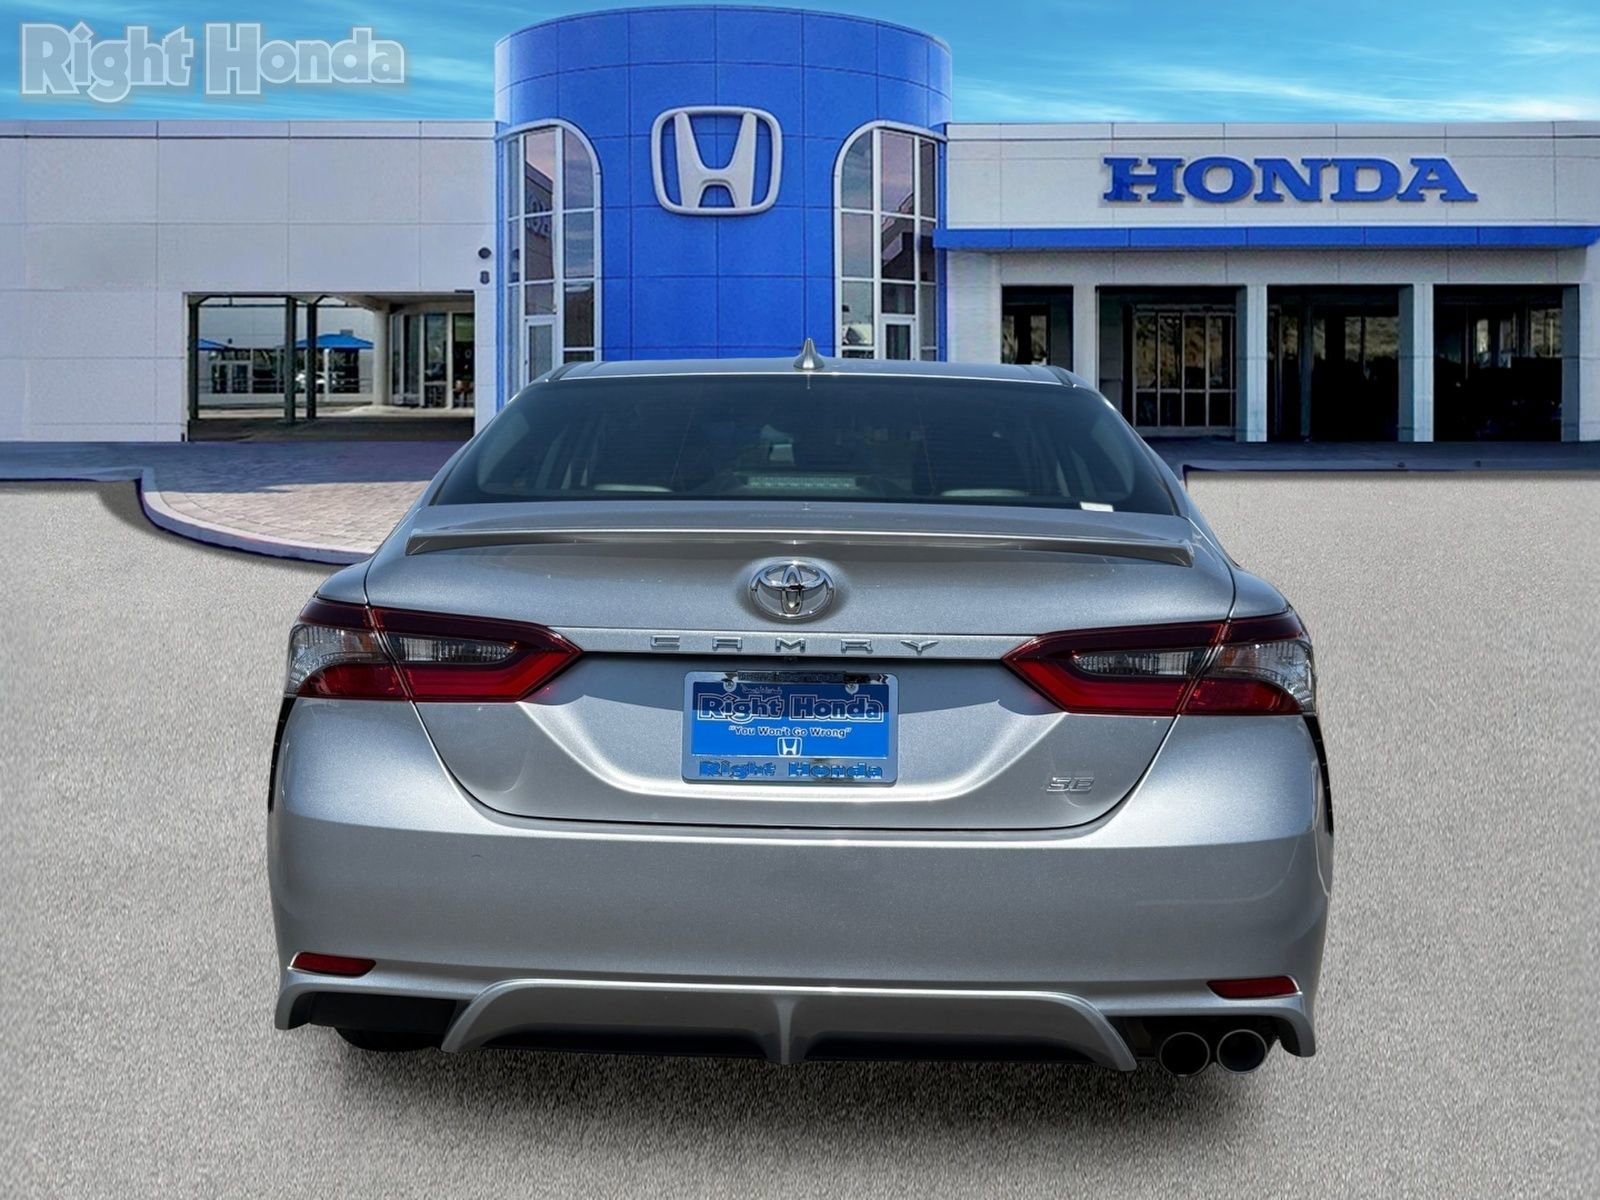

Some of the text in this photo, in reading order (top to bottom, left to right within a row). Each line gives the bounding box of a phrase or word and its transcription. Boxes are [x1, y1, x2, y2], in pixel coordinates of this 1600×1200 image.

[1103, 156, 1478, 203] HONDA
[650, 634, 939, 655] CAMRY
[697, 692, 885, 724] Right Honda
[792, 727, 808, 737] Go
[699, 760, 883, 780] Right Honda
[1046, 776, 1095, 793] SE
